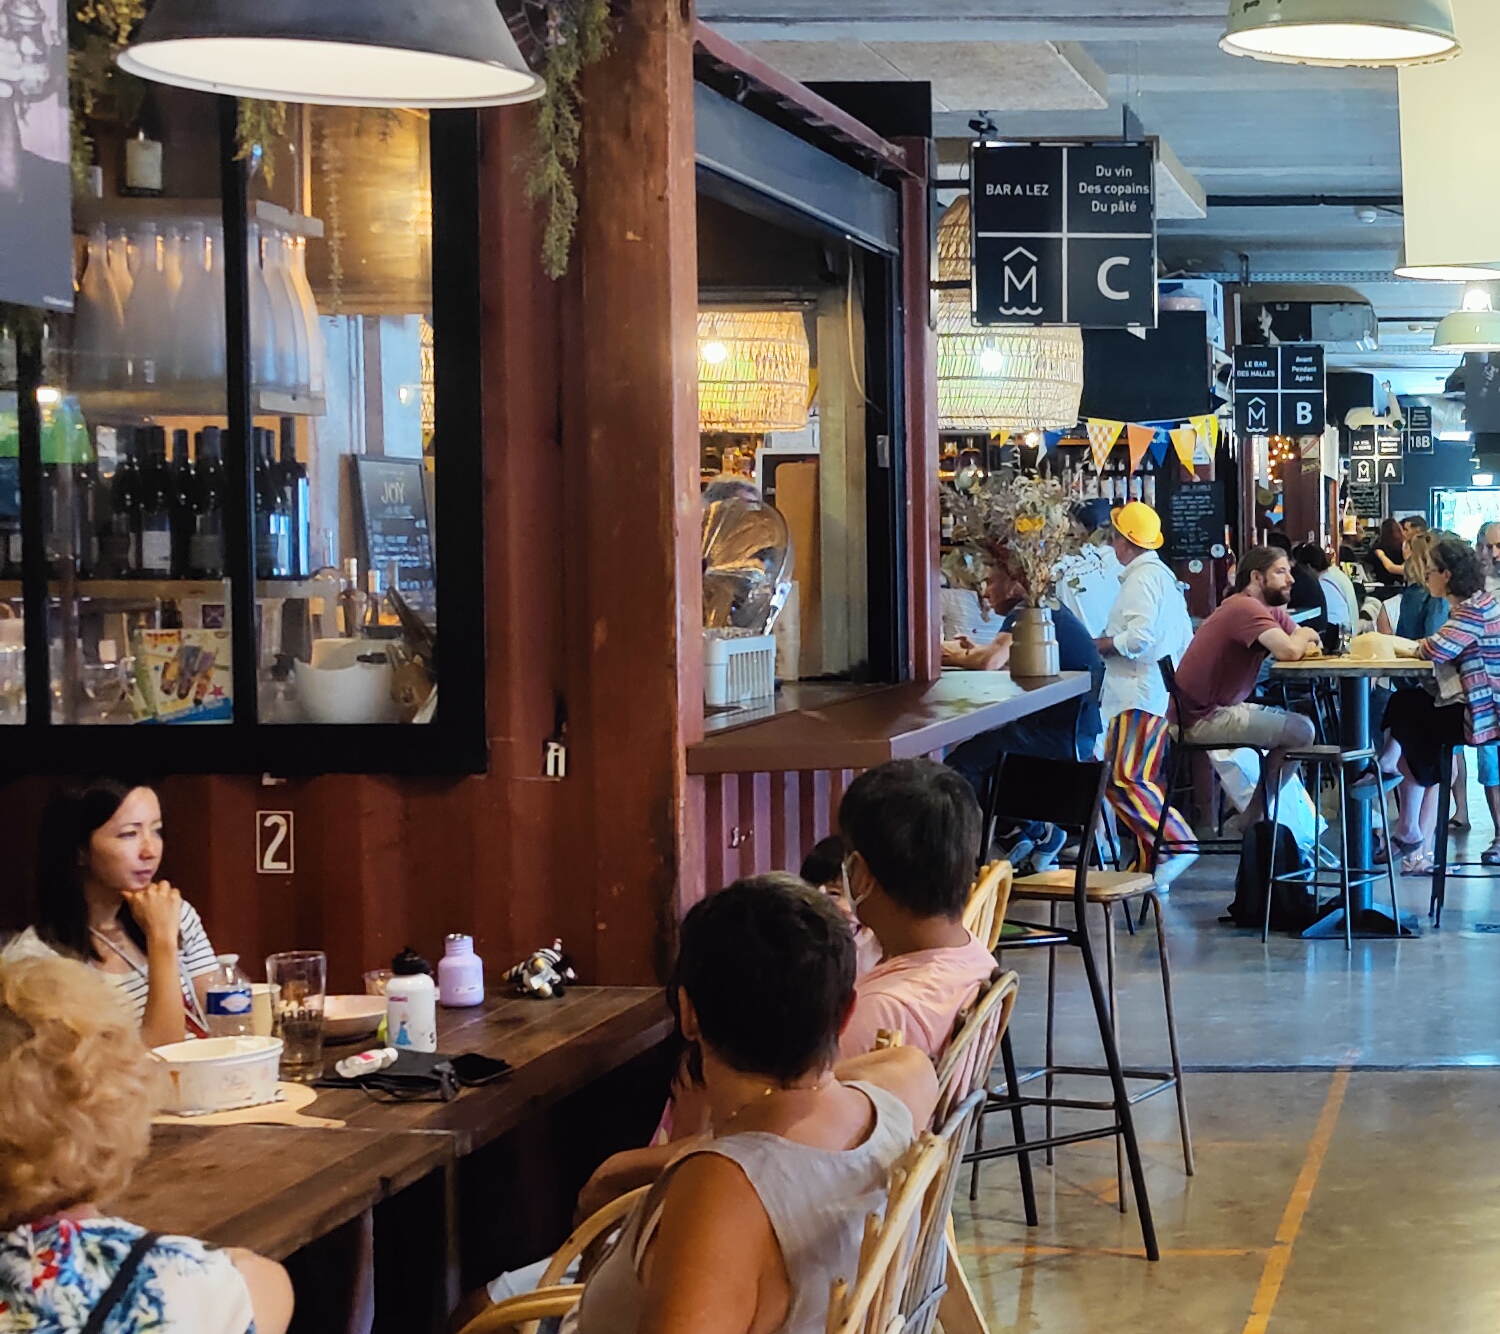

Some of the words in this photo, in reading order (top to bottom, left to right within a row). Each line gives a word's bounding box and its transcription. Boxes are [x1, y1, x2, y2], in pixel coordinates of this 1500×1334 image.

[1096, 165, 1111, 177] Du
[1114, 165, 1132, 177] vin
[986, 184, 1011, 195] BAR
[1014, 184, 1023, 195] A
[1026, 184, 1049, 196] LEZ
[1078, 183, 1101, 194] Des
[1104, 182, 1150, 196] copains
[1092, 201, 1109, 212] Du
[1111, 200, 1137, 214] pâté
[1097, 257, 1130, 300] C
[1296, 402, 1312, 424] B
[1410, 435, 1431, 449] 18B
[1384, 463, 1396, 478] A
[263, 814, 288, 870] 2
